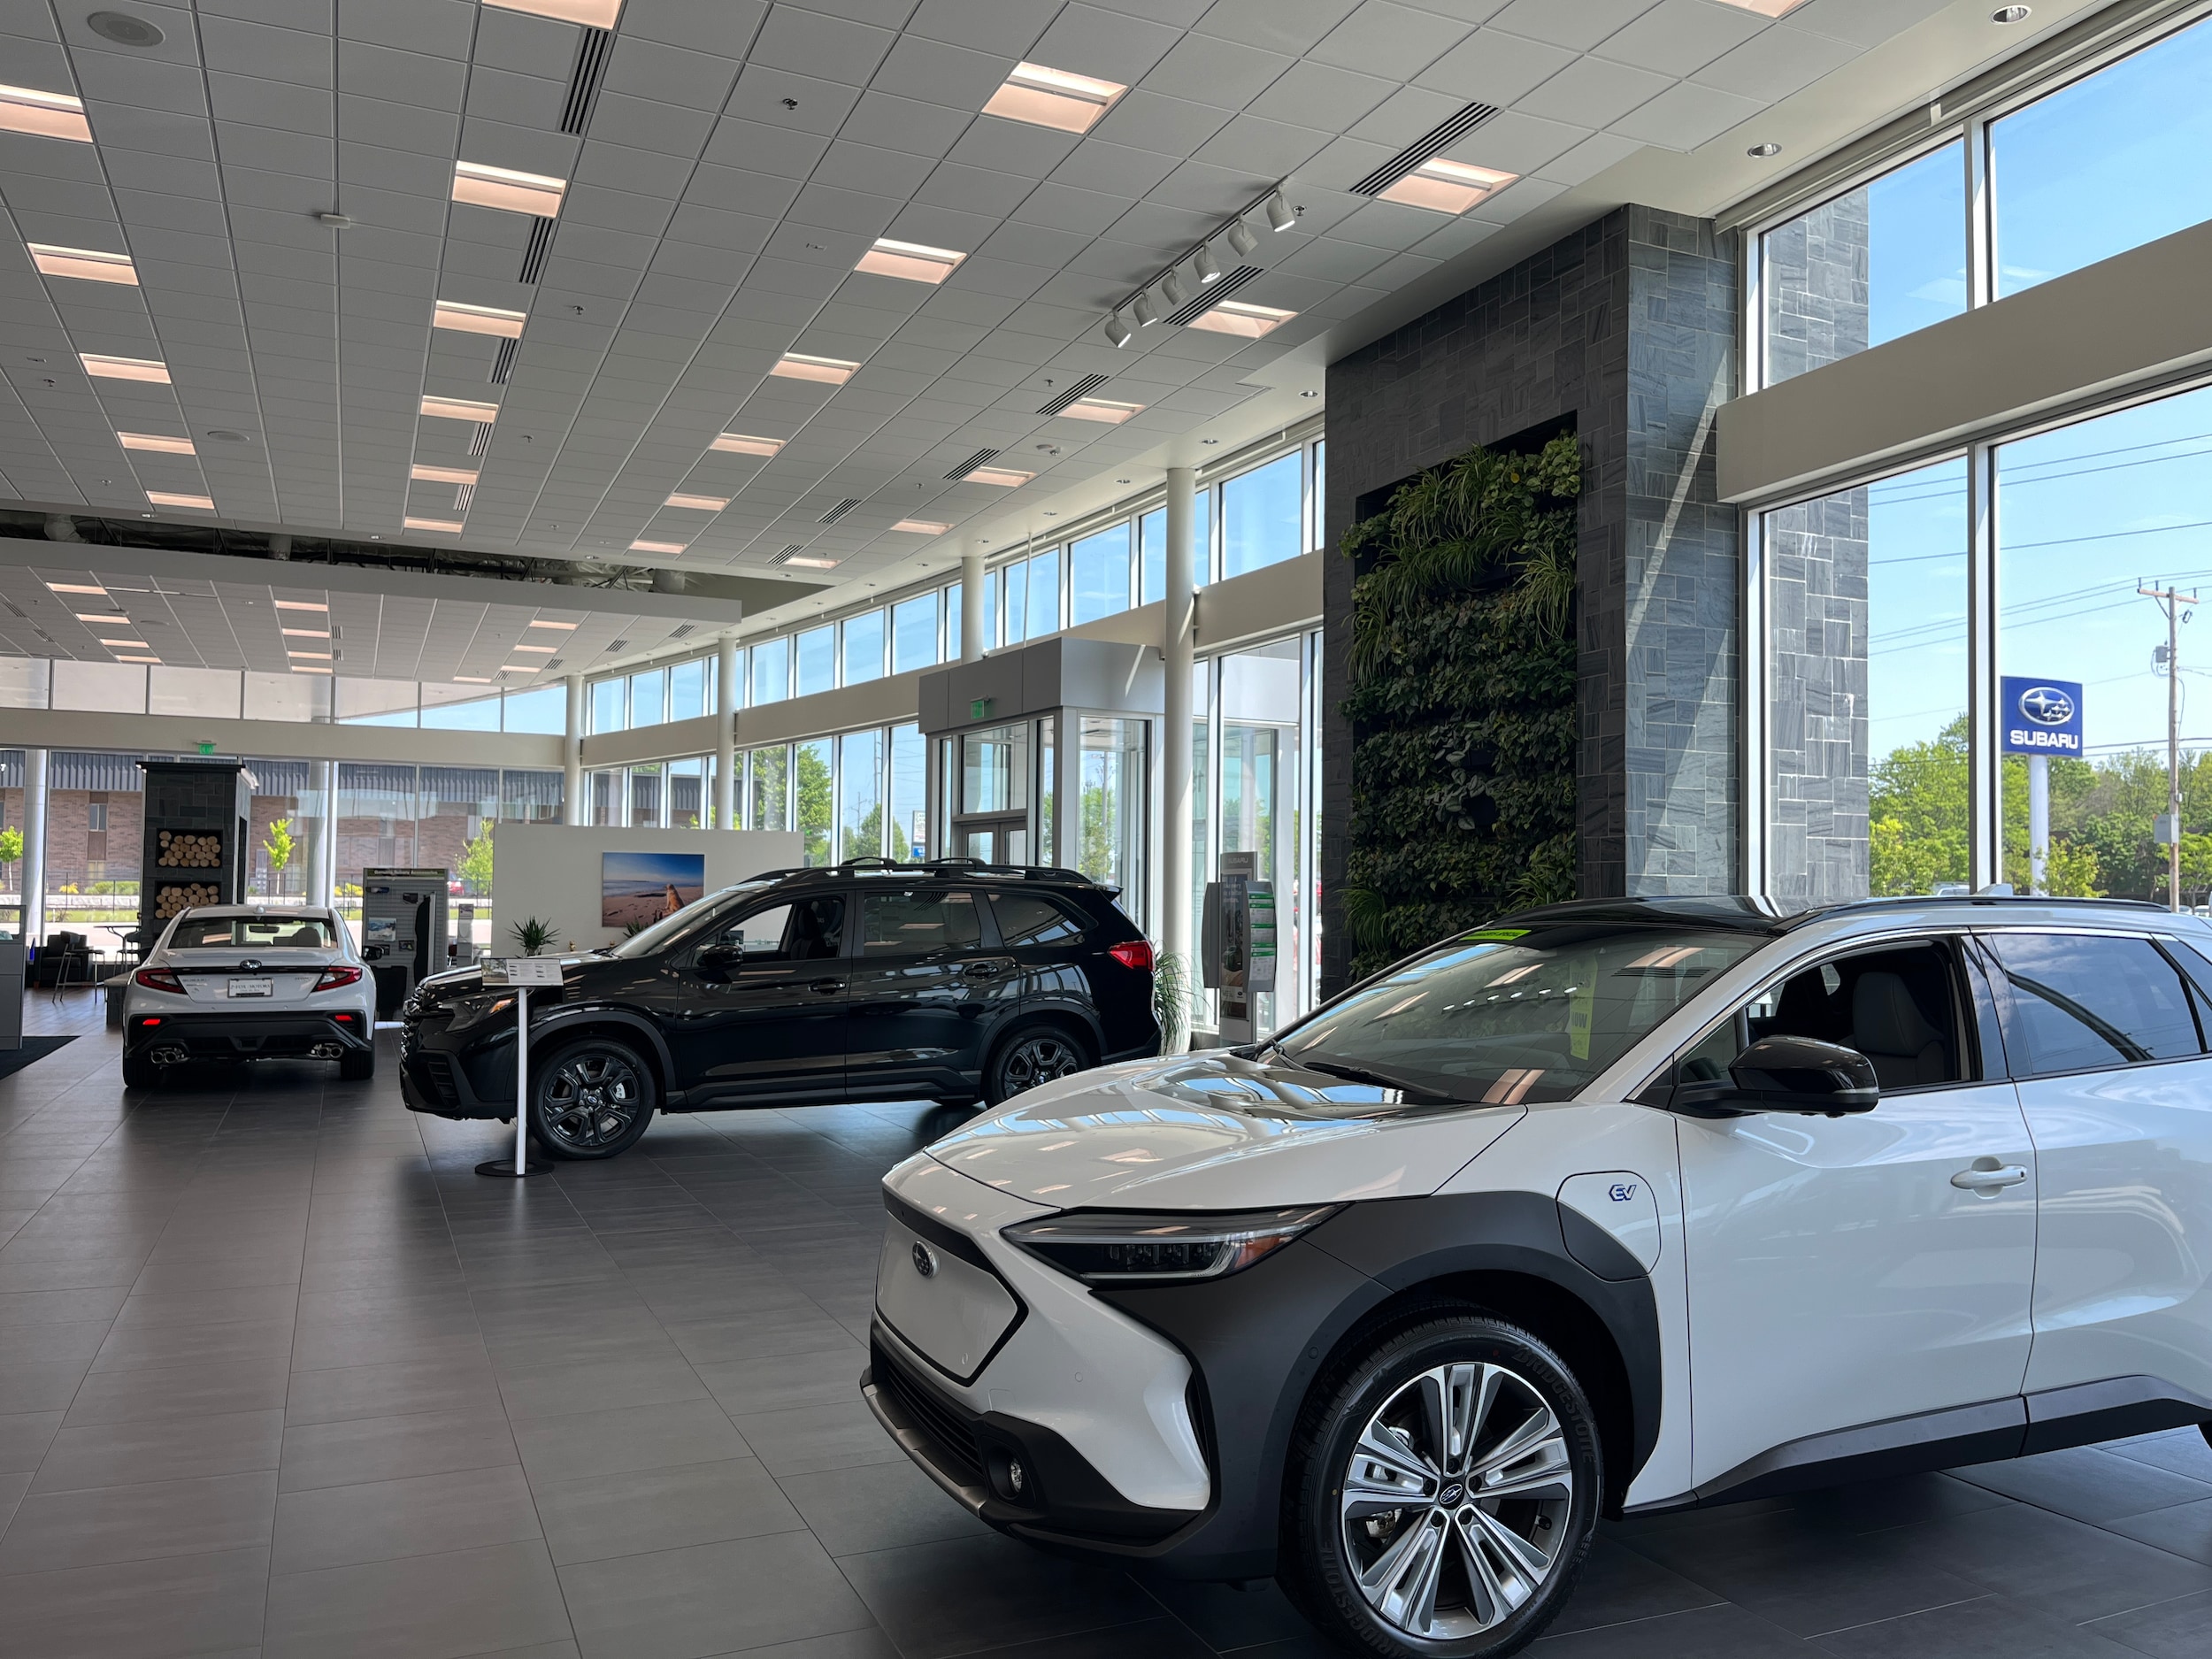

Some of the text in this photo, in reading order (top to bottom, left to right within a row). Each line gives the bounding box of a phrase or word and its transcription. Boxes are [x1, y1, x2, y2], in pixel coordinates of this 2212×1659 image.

[2009, 729, 2078, 749] SUBARU
[1609, 1184, 1637, 1202] EV
[1511, 1344, 1595, 1464] BRIDGESTONE
